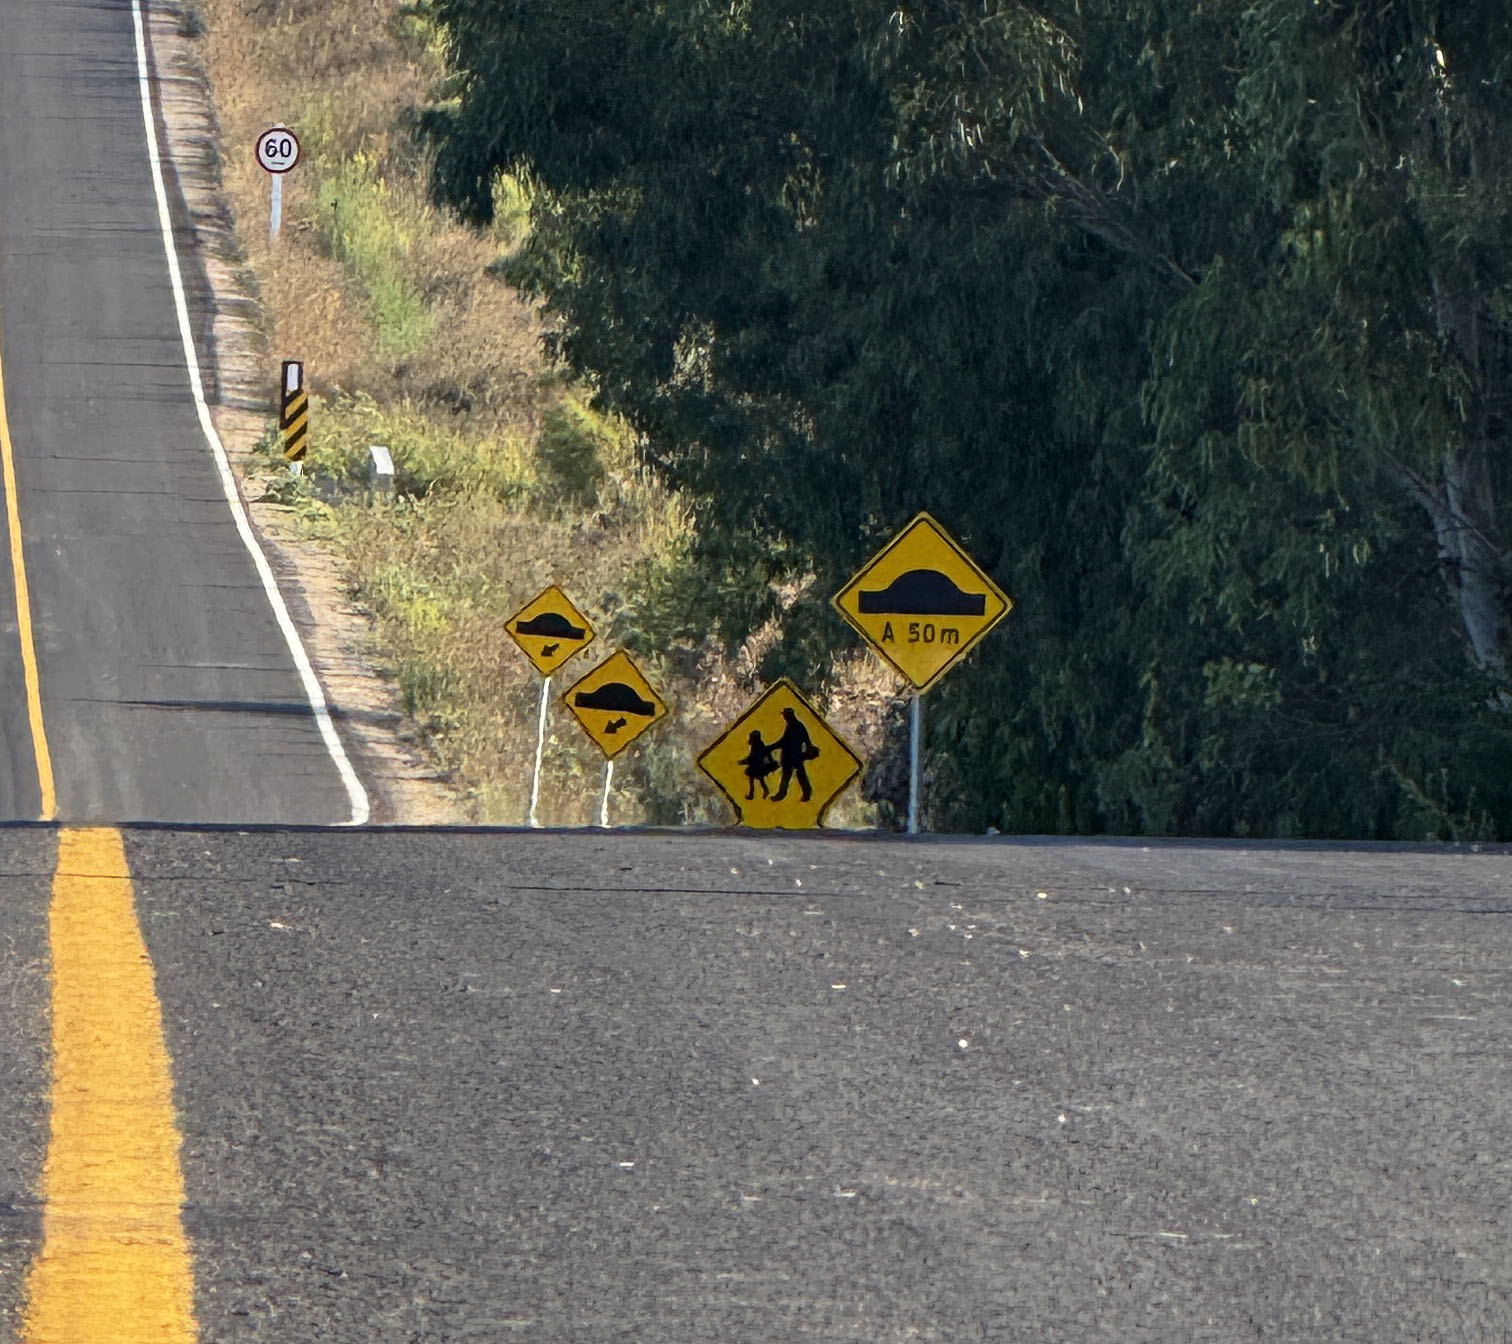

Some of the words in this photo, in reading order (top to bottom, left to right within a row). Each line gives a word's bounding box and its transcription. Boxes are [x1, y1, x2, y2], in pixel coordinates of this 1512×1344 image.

[265, 138, 292, 158] 60
[881, 621, 896, 644] A
[908, 622, 960, 645] 50m
